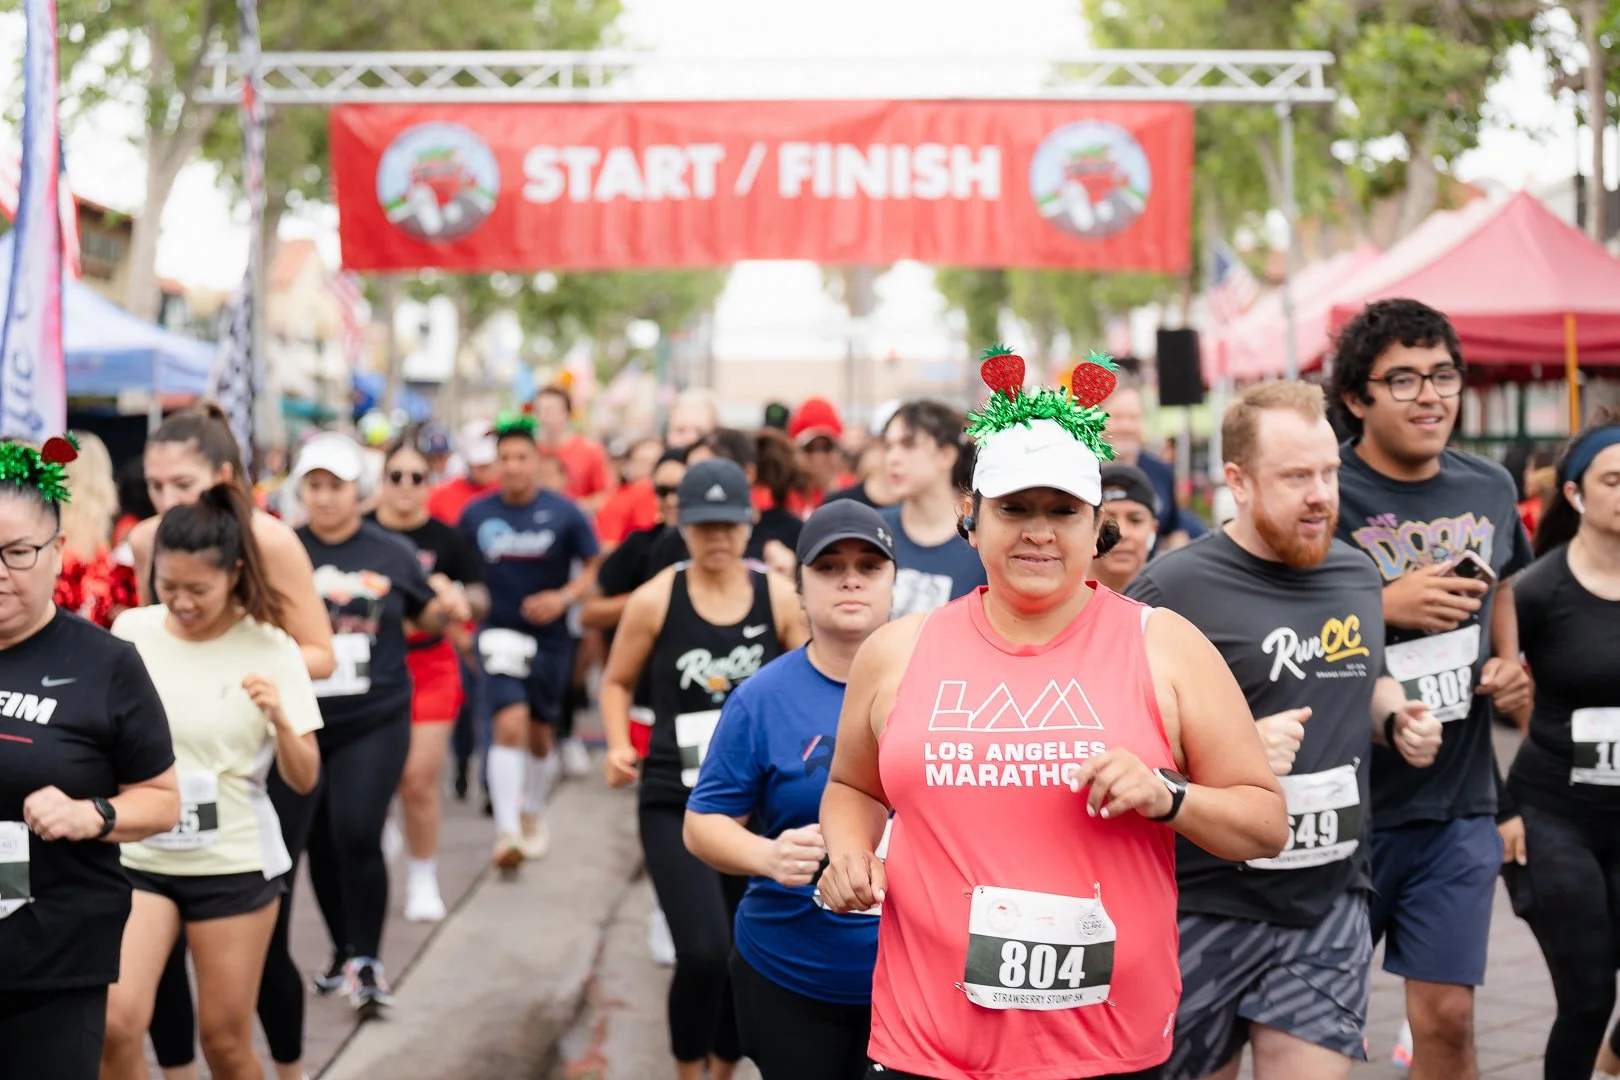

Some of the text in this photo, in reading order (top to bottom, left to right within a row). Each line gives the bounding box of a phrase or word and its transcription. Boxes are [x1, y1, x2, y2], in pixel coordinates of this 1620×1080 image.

[522, 142, 1000, 203] START / FINISH
[1352, 512, 1495, 581] DOOM
[1262, 614, 1362, 682] RunOC
[924, 741, 1106, 761] LOS ANGELES
[925, 763, 1081, 787] MARATHO
[999, 941, 1085, 989] 804
[992, 992, 1045, 1004] STRAWBERRY
[1047, 993, 1073, 1004] STOMP
